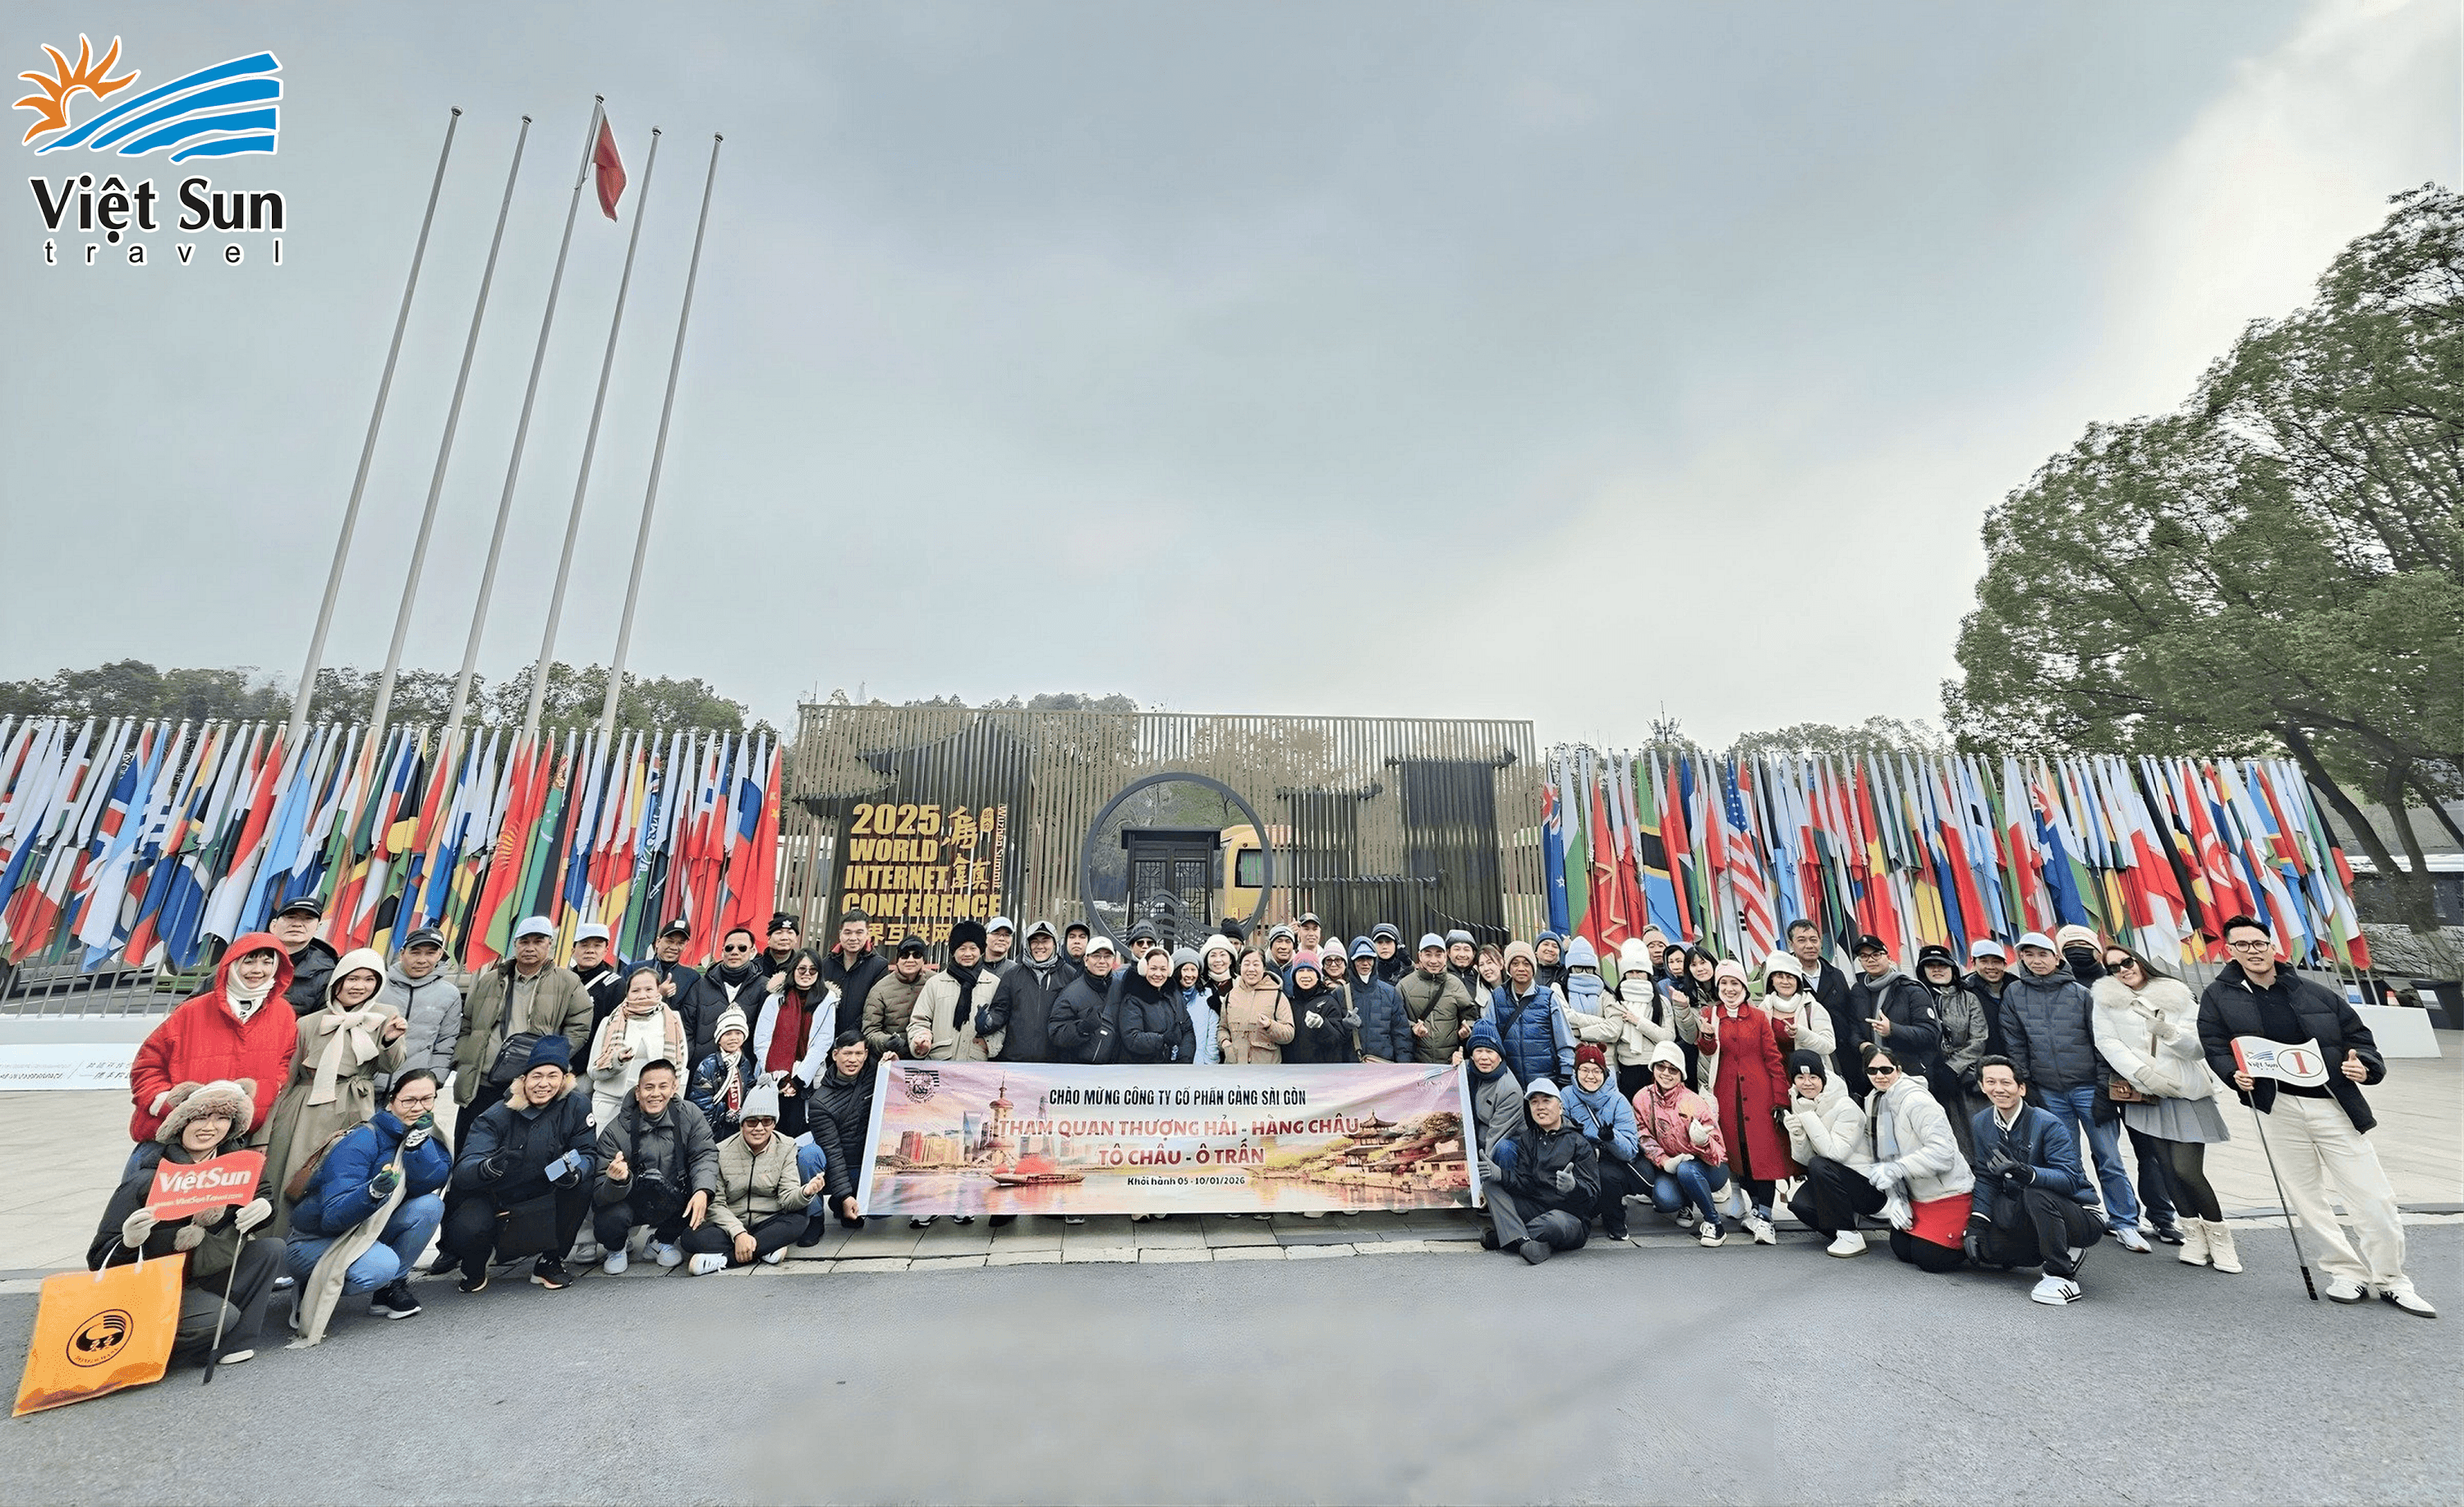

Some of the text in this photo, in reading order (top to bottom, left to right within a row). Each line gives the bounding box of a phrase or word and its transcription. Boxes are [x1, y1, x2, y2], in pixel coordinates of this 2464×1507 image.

[851, 803, 940, 835] 2025
[849, 838, 939, 862] WORLD
[993, 805, 1007, 889] Wuzhen Summit
[844, 865, 949, 890] INTERNET
[842, 893, 1001, 917] CONFERENCE
[2290, 1051, 2312, 1074] 1
[1049, 1086, 1080, 1105] CHÀO
[1084, 1086, 1119, 1105] MỪNG
[1124, 1085, 1154, 1105] CÔNG
[1158, 1090, 1170, 1105] TY
[1228, 1084, 1257, 1105] CẢNG
[1262, 1086, 1280, 1105] SÀI
[1284, 1086, 1306, 1105] GÒN
[999, 1119, 1053, 1137] THAM
[1058, 1119, 1115, 1140] QUAN
[1119, 1117, 1199, 1142] THƯỢNG
[1204, 1114, 1237, 1136] HẢI
[1252, 1114, 1304, 1135] HÀNG
[1308, 1113, 1358, 1134] CHÂU
[1099, 1142, 1124, 1165] TÔ
[1128, 1142, 1182, 1165] CHÂU
[1195, 1142, 1210, 1165] Ô
[1214, 1137, 1264, 1165] TRẤN
[159, 1166, 252, 1193] ViệtSun
[1151, 1176, 1176, 1185] hành
[1178, 1177, 1188, 1185] 05
[1195, 1177, 1245, 1185] 10/01/2026
